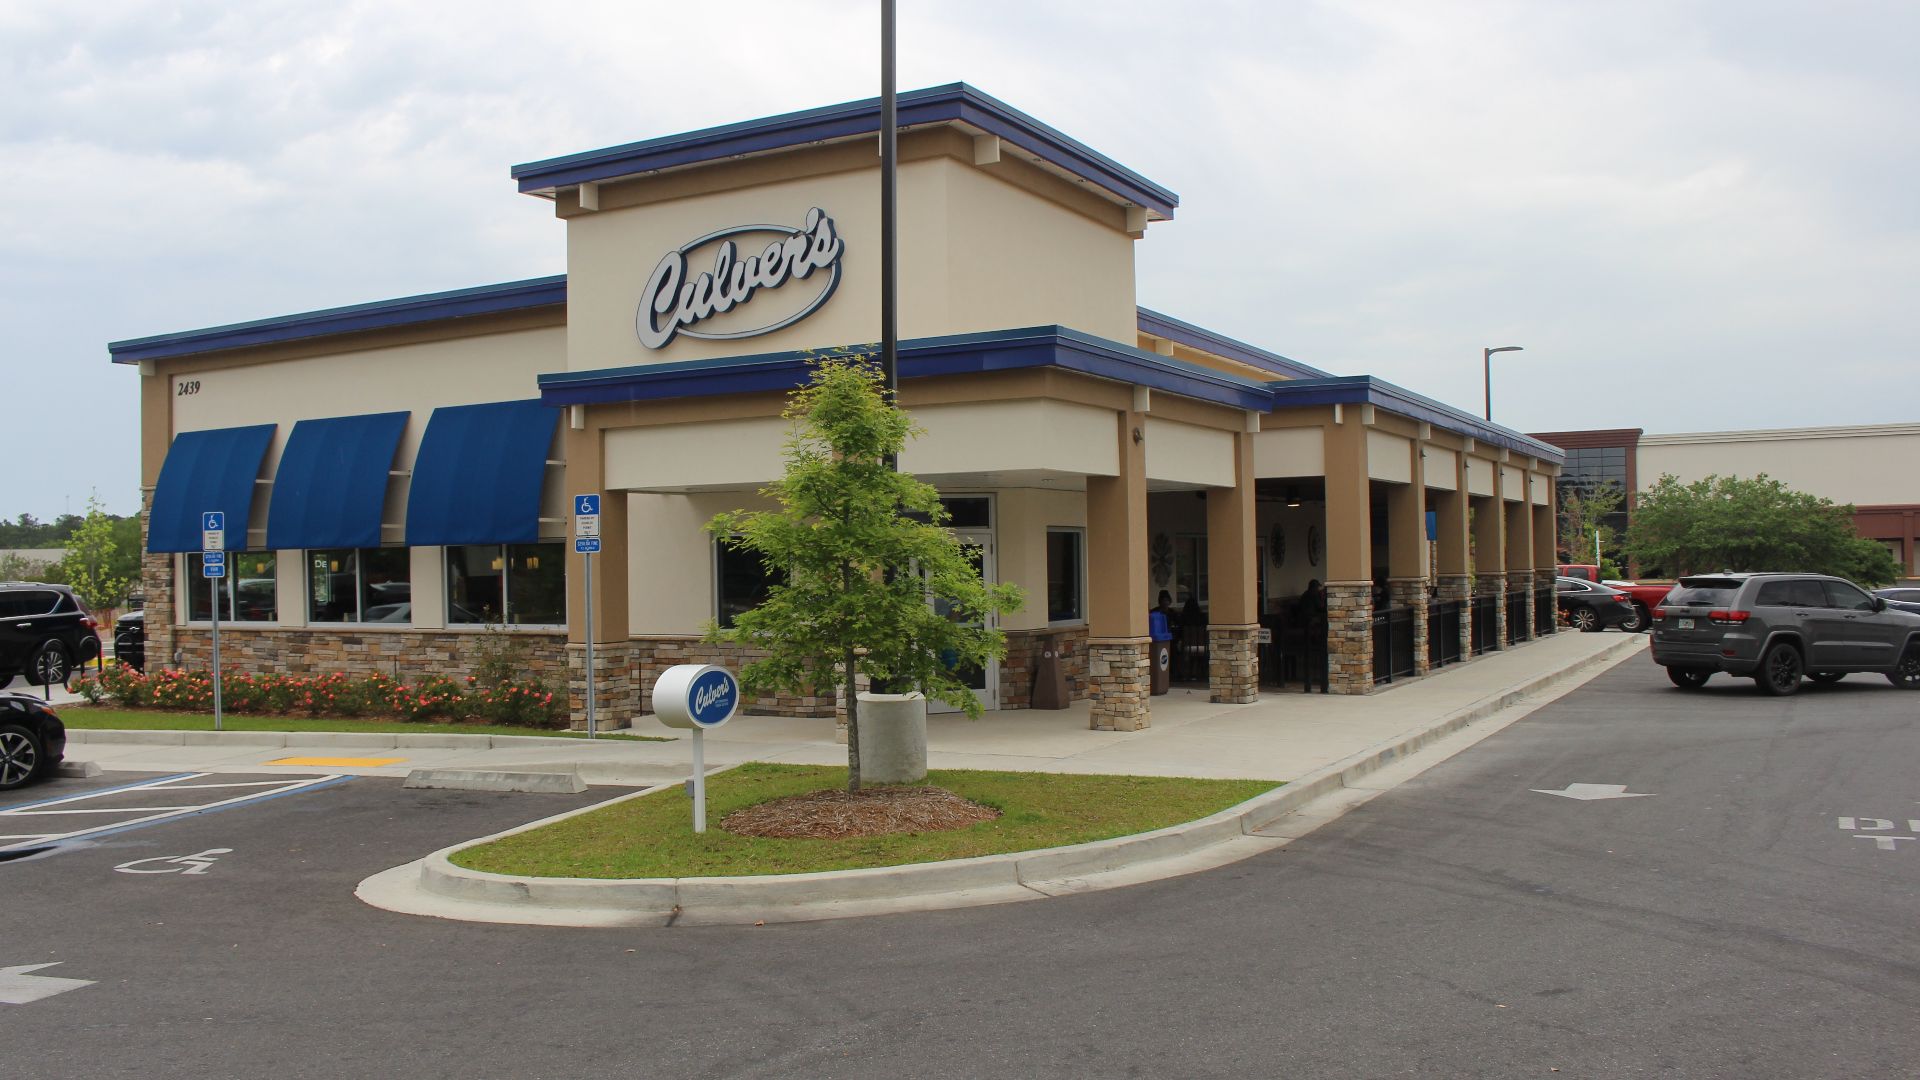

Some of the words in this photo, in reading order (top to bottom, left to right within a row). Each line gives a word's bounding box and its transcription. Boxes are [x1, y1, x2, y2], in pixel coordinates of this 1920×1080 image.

[636, 207, 844, 349] Culver's
[178, 381, 200, 396] 2439
[695, 676, 729, 715] Culver's
